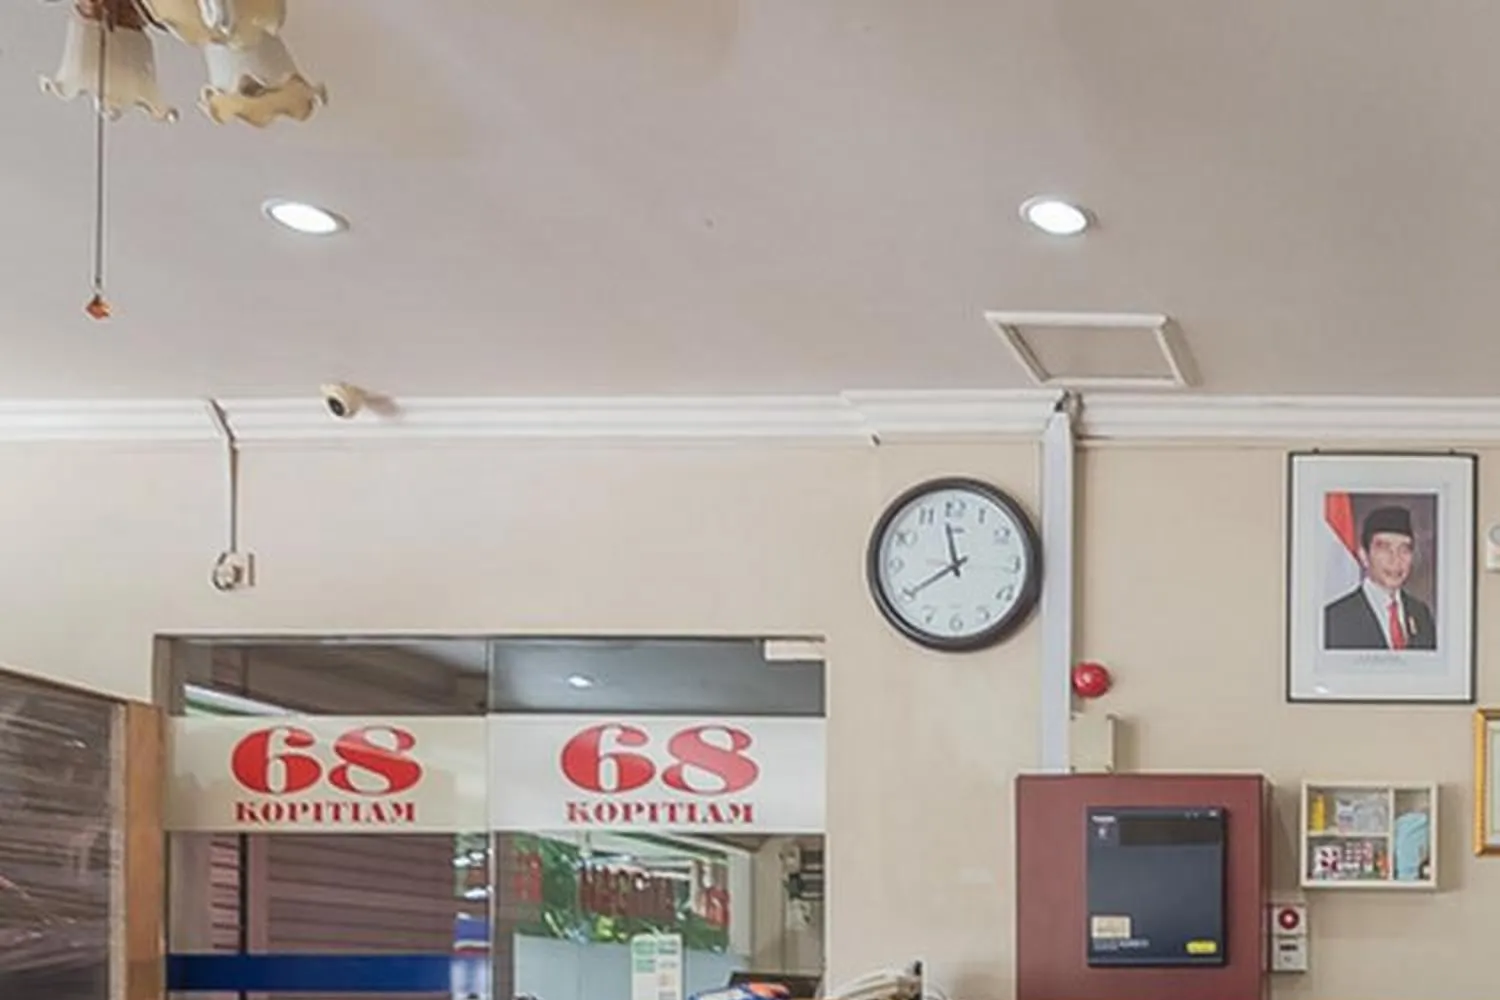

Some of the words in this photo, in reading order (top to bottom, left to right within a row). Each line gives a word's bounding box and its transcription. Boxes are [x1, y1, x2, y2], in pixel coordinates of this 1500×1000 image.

[918, 507, 935, 525] 11
[945, 501, 966, 518] 12
[896, 531, 918, 547] 10
[949, 613, 964, 631] 6
[231, 725, 424, 796] 68
[560, 723, 760, 796] 68
[235, 801, 416, 823] KOPITIAM
[566, 801, 755, 824] KOPITIAM
